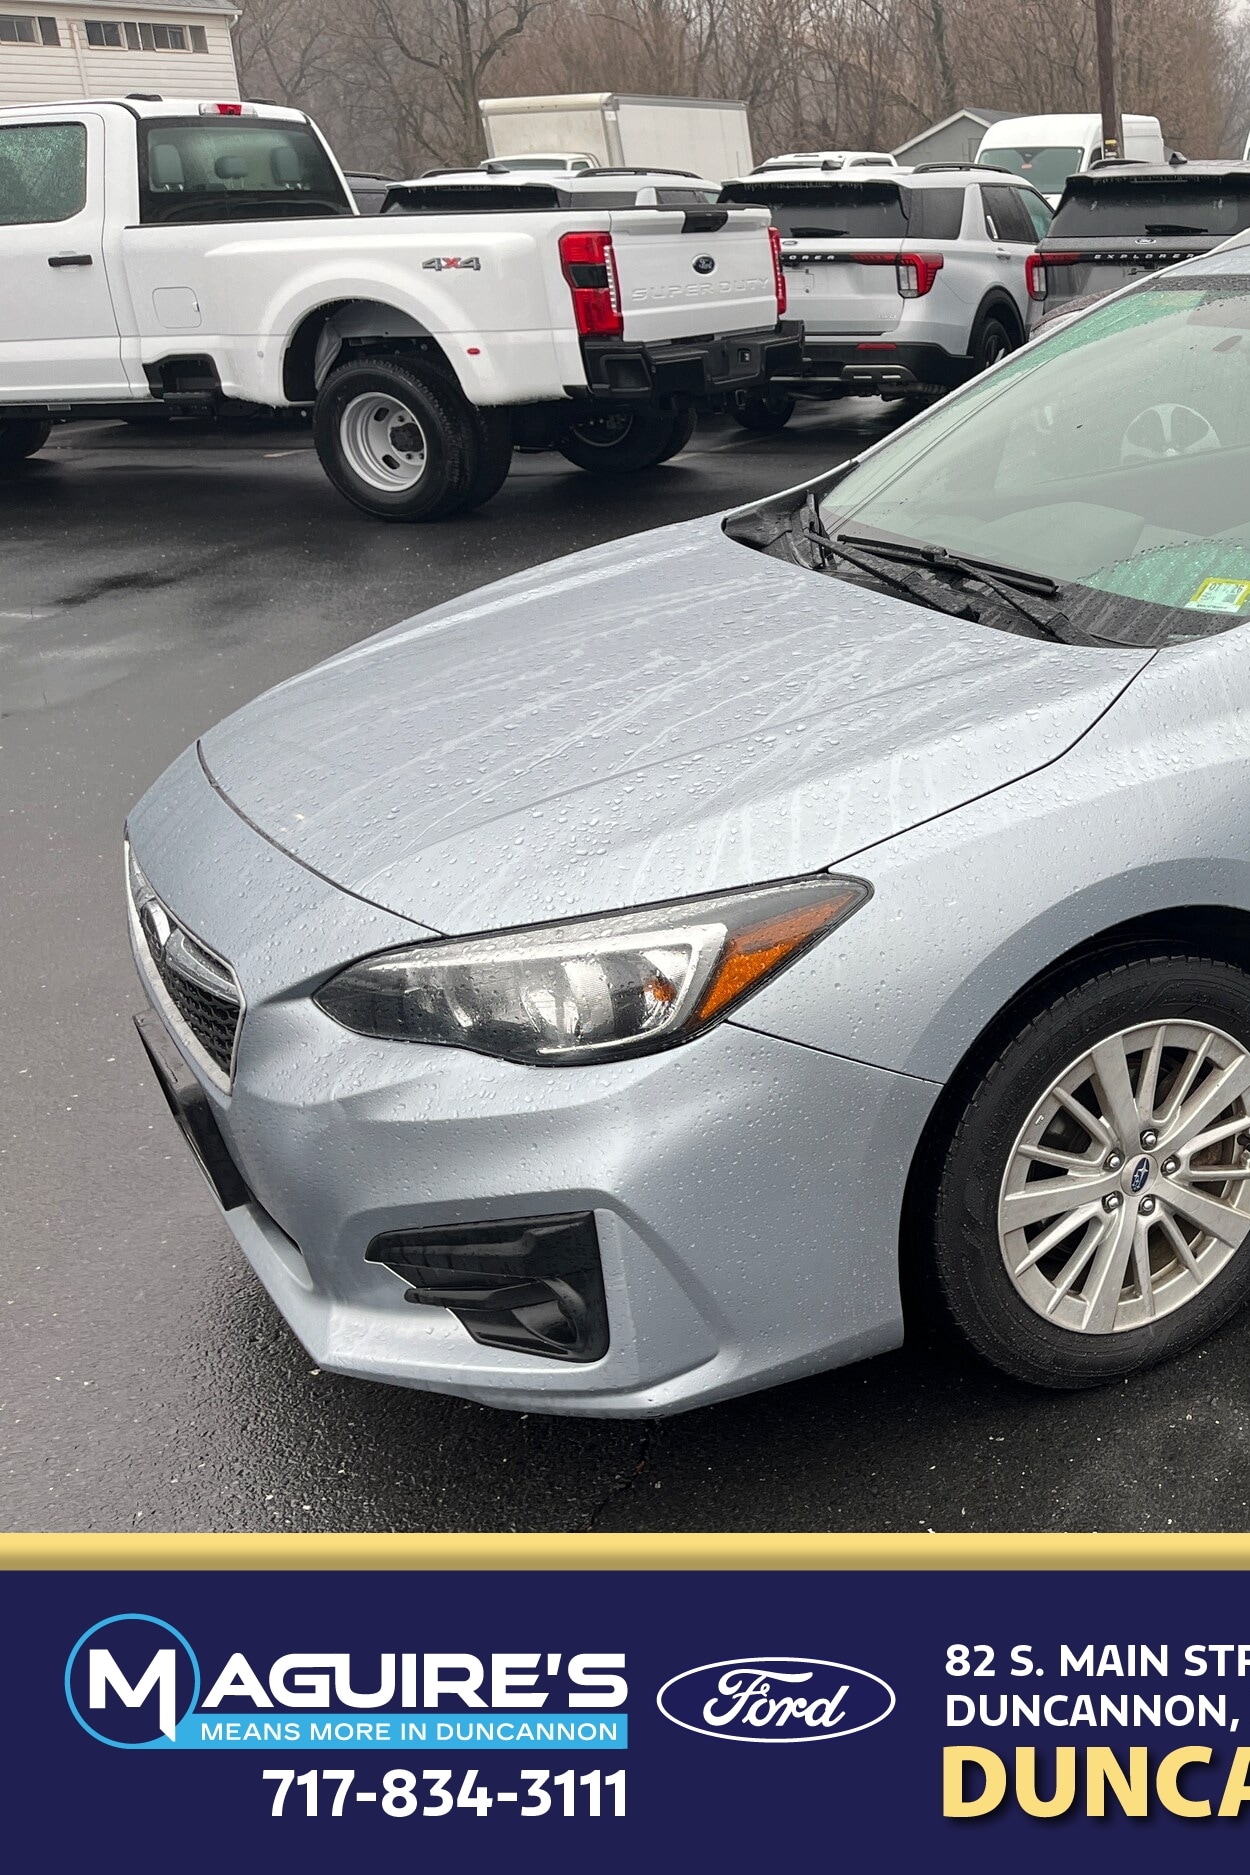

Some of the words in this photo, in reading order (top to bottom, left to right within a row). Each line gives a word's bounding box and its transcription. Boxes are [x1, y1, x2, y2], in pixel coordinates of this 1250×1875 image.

[1094, 252, 1194, 260] EXPLORER
[632, 283, 714, 301] SUPER
[719, 277, 768, 294] DUTY
